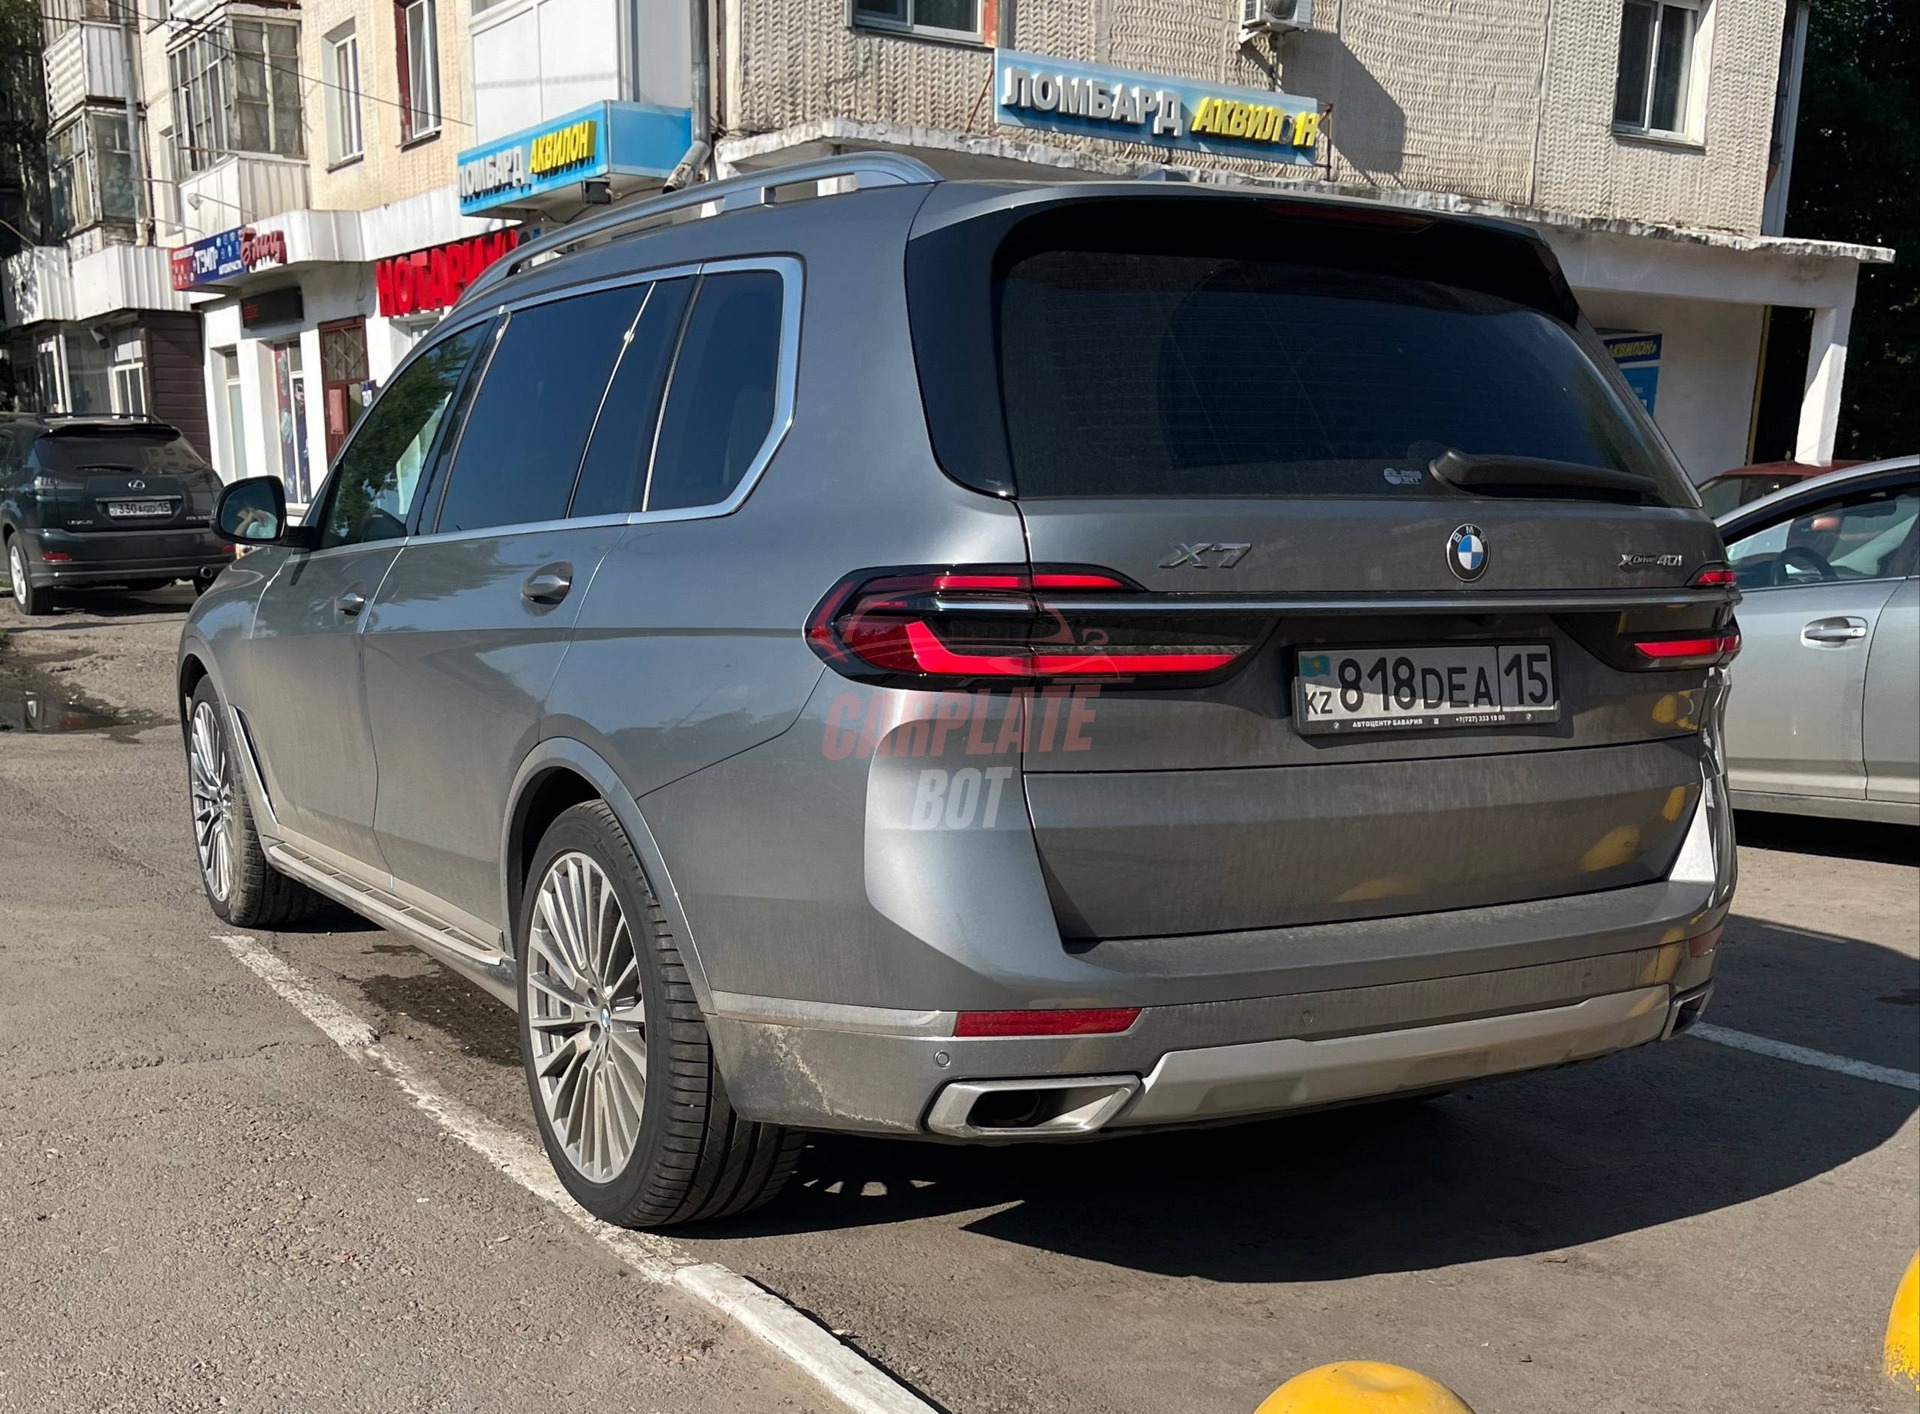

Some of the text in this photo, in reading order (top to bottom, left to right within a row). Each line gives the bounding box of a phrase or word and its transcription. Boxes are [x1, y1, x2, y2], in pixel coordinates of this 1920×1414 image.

[1001, 67, 1183, 136] ЛОМБАРД
[458, 120, 597, 197] ЛОМБАРД АКВИЛОН
[158, 501, 170, 513] 15
[1159, 542, 1252, 568] X7
[1338, 653, 1549, 712] 818DEA 15
[1306, 691, 1333, 714] KZ
[1352, 718, 1423, 728] АВТОЦЕНТР БАВАРИЯ
